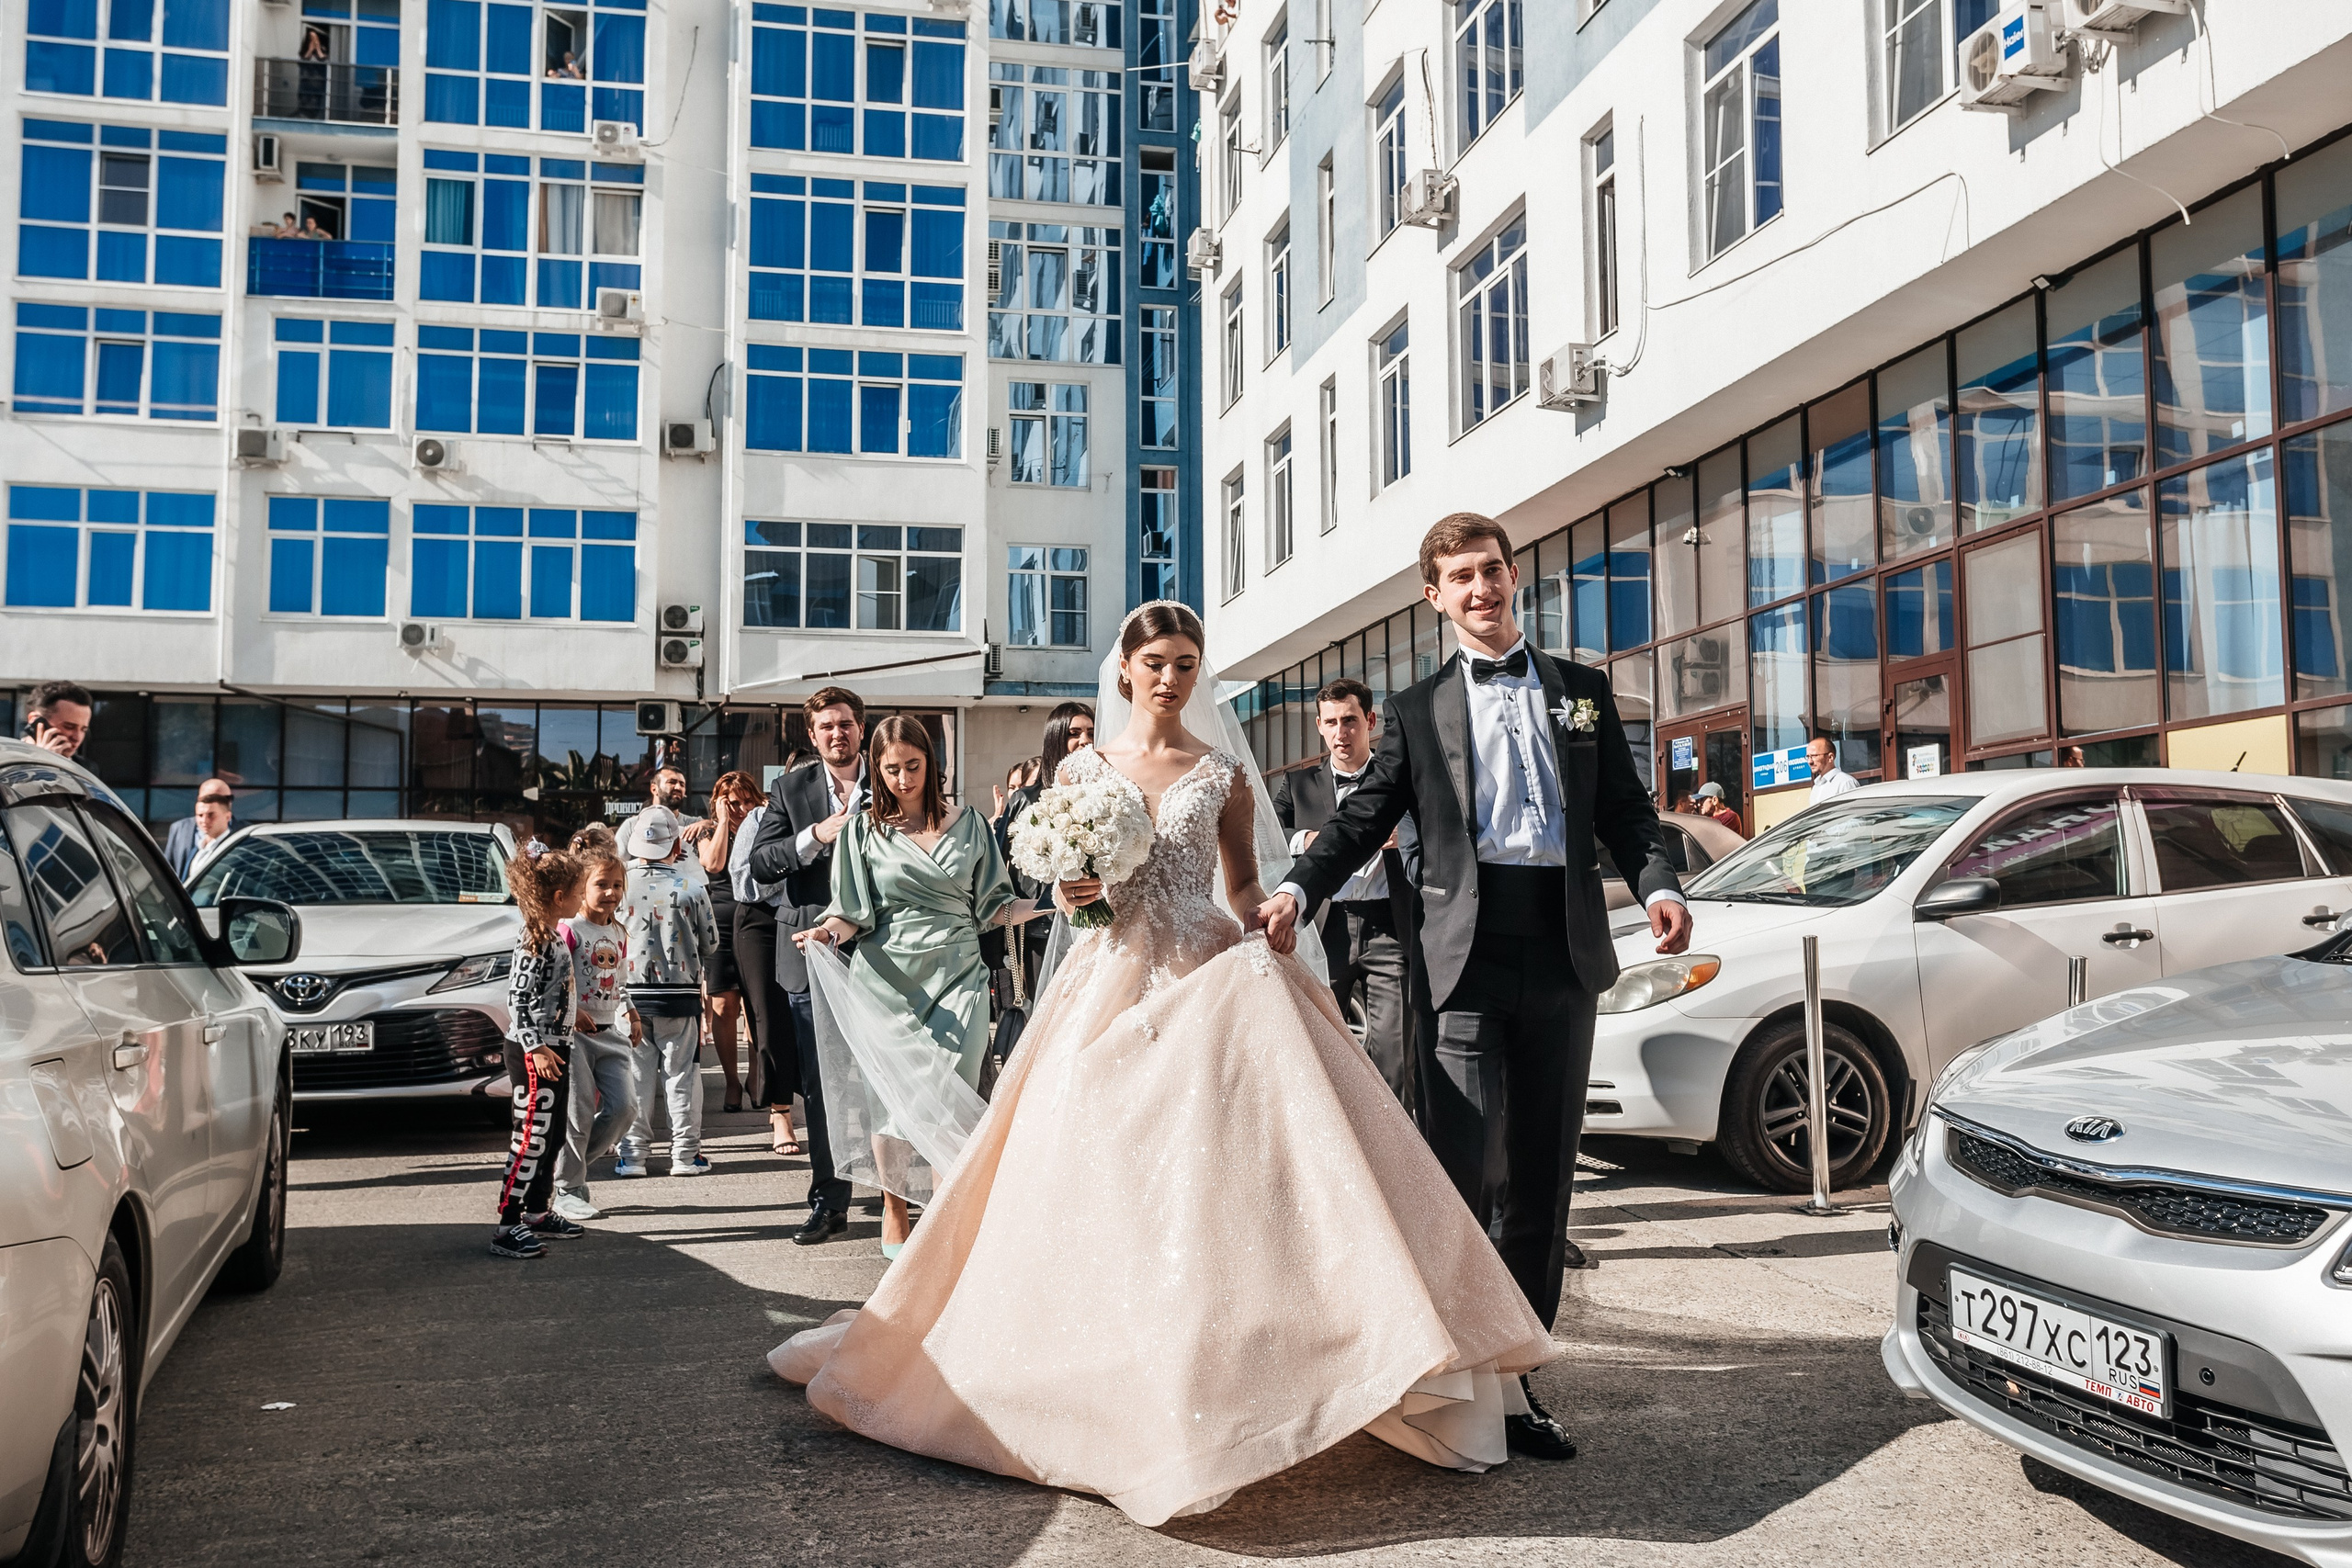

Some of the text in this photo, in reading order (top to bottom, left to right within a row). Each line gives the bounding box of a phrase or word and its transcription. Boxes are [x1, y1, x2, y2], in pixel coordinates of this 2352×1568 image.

[2003, 28, 2024, 51] Haier
[1776, 761, 1788, 773] 206
[332, 1024, 366, 1041] 193
[2069, 1117, 2114, 1138] KIA
[1996, 1346, 2014, 1360] (861)
[2095, 1325, 2152, 1377] 123
[2109, 1367, 2138, 1390] RUS
[2085, 1379, 2154, 1413] ТЕМП АВТО
